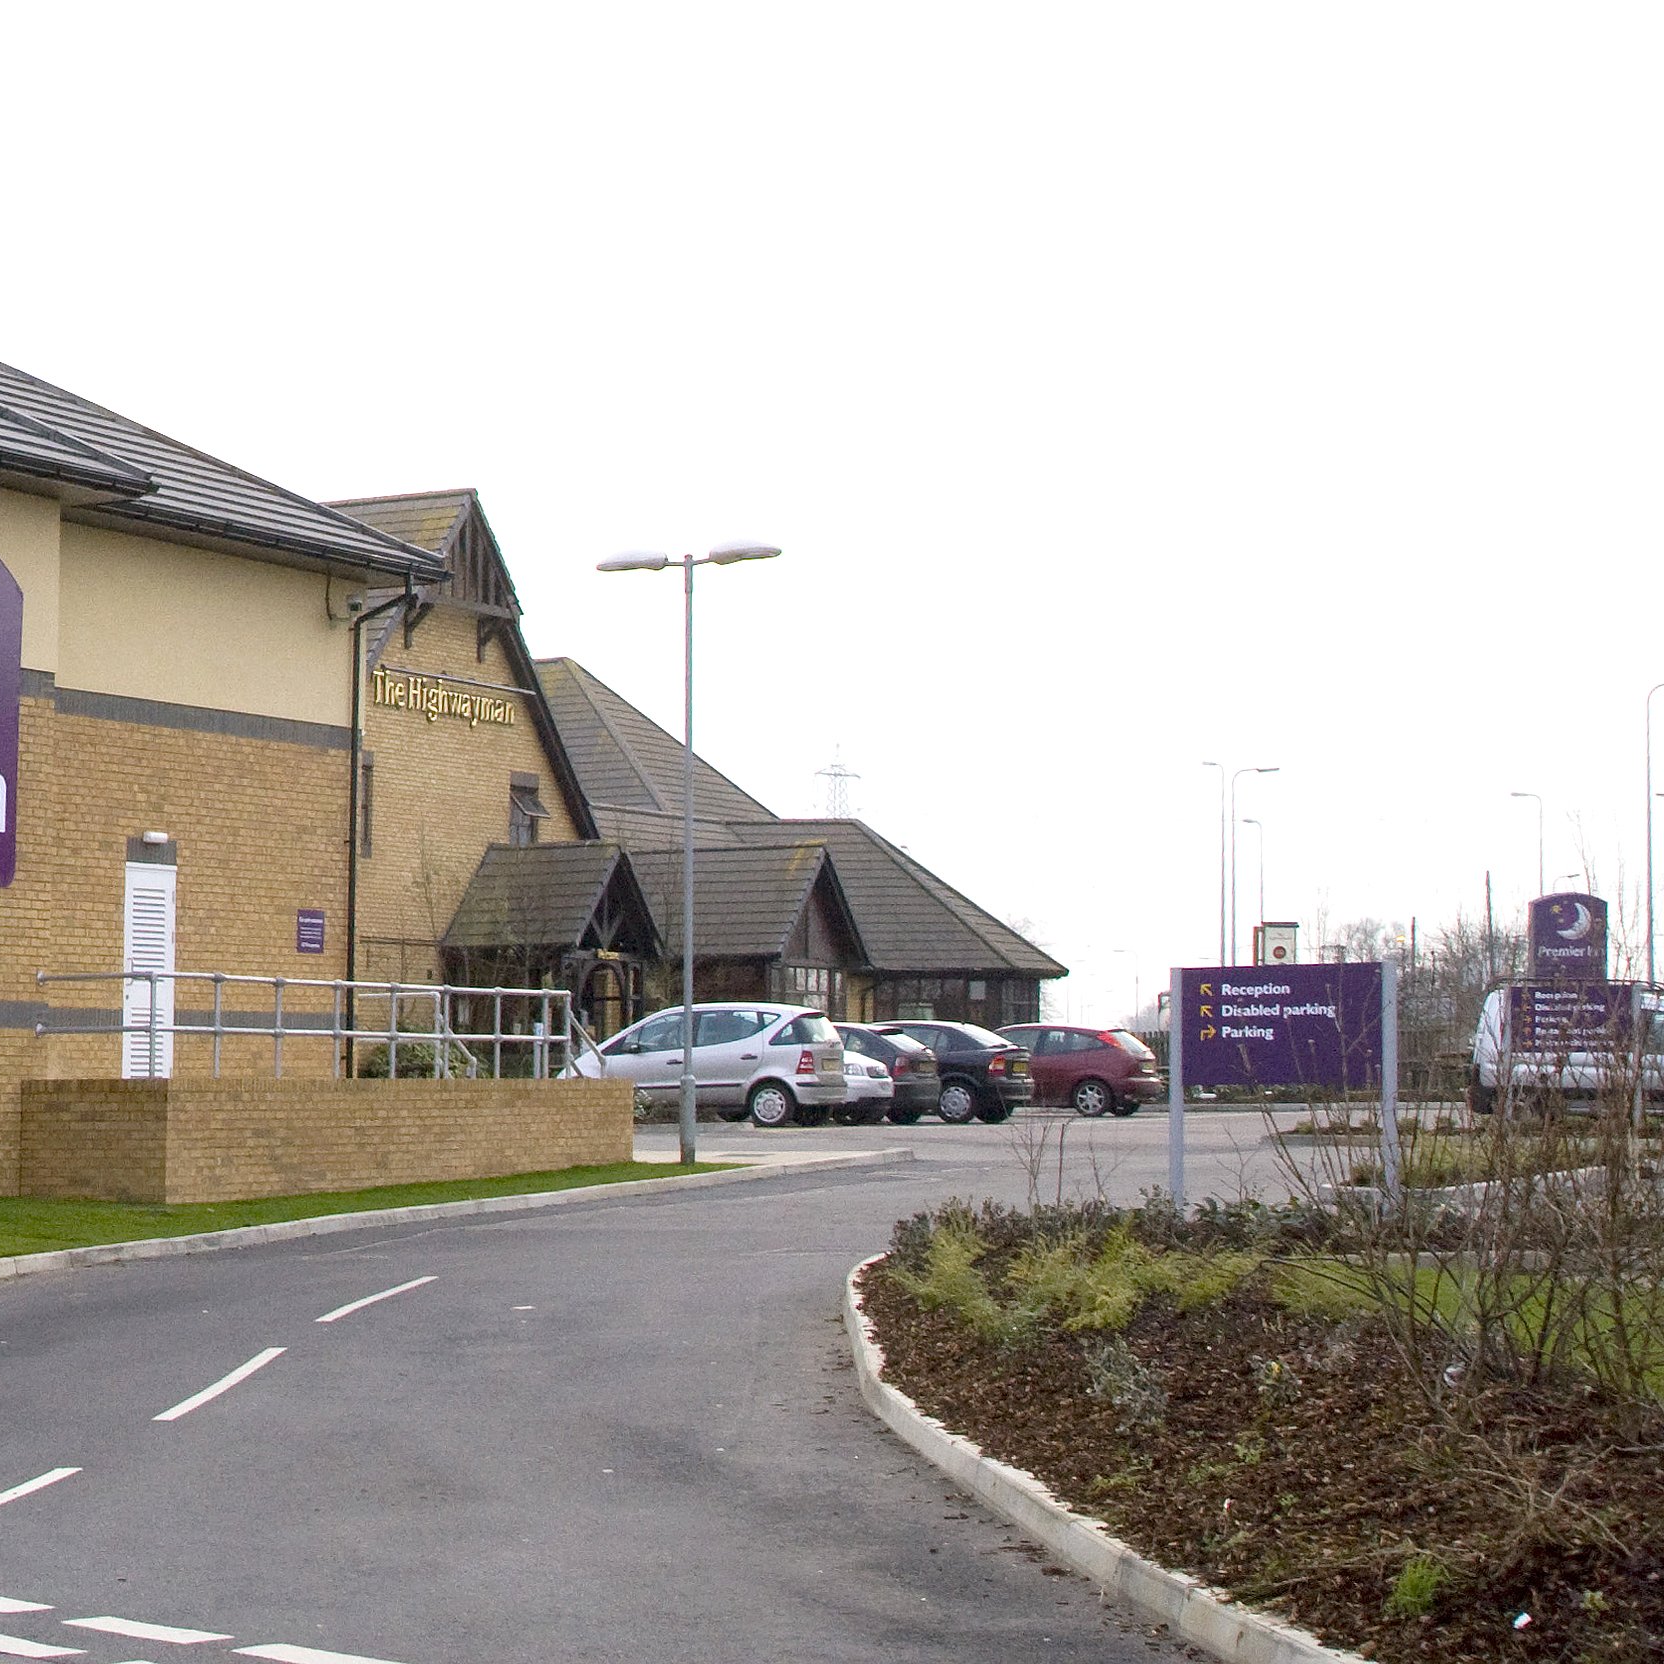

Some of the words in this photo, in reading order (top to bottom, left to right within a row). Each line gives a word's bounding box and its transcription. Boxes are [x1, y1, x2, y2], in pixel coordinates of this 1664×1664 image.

[373, 669, 406, 707] The
[408, 677, 515, 726] Highwayman
[1538, 944, 1586, 957] Premier
[1222, 982, 1291, 997] Reception
[1222, 1003, 1281, 1017] Disabled
[1283, 1003, 1336, 1019] parking
[1222, 1025, 1274, 1040] Parking
